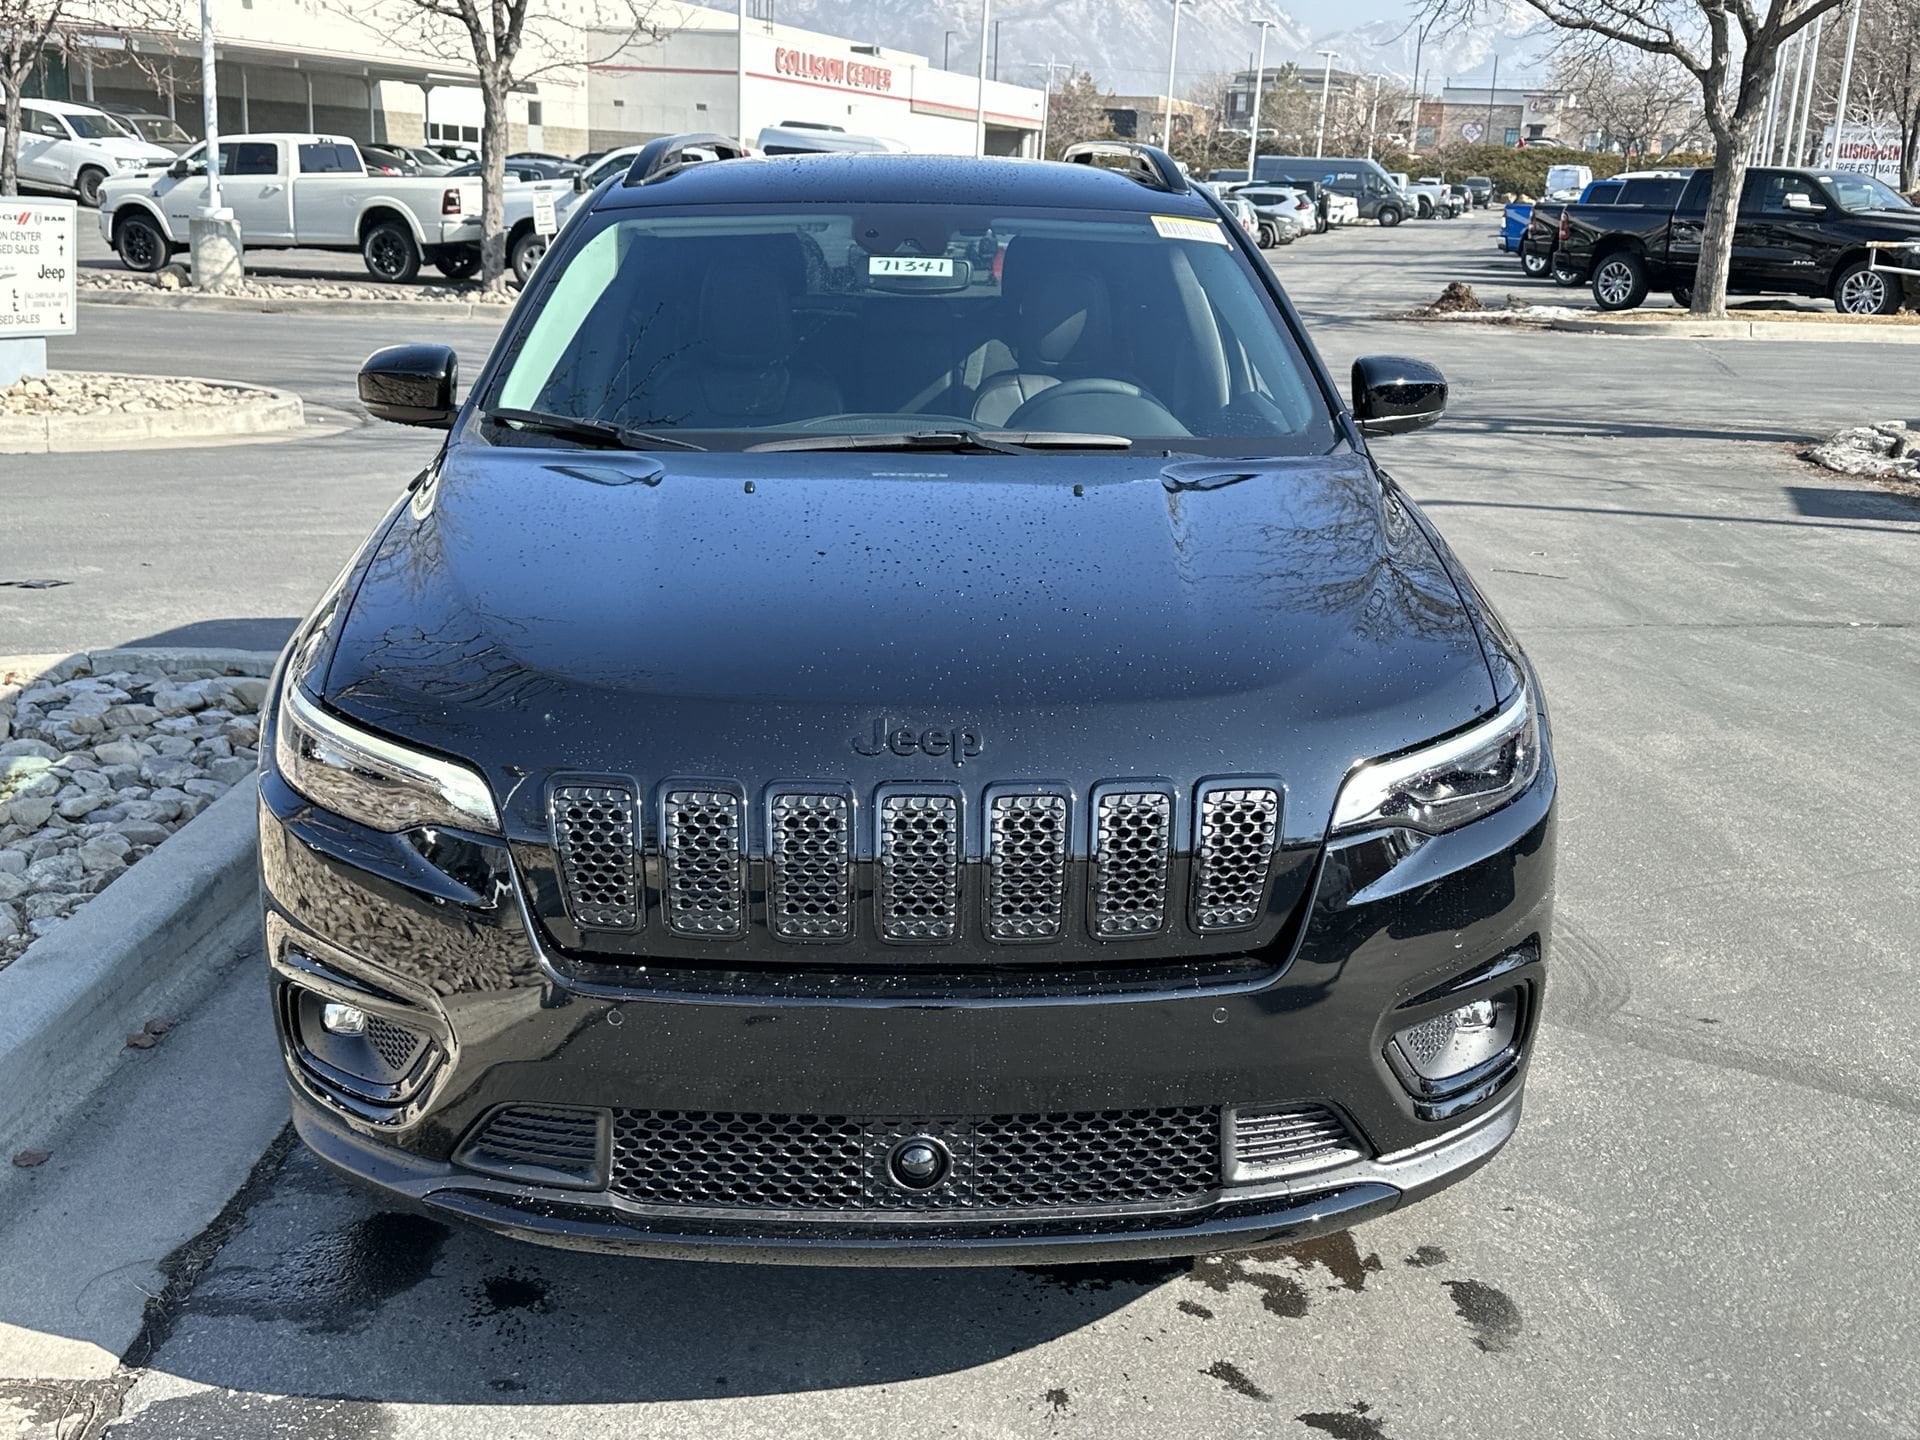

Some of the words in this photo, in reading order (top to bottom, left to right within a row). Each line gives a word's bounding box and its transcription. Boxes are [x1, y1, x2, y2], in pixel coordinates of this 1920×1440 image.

[775, 47, 844, 82] COLLISION
[846, 61, 891, 90] CENTER
[1825, 143, 1877, 159] CLLISION
[1880, 144, 1901, 160] CEN
[1836, 162, 1857, 172] REE
[10, 231, 42, 241] CENTER
[15, 244, 40, 254] SALES
[877, 260, 944, 273] 71341
[38, 264, 66, 283] Jeep
[15, 314, 41, 325] SALES
[852, 718, 984, 768] Jeep
